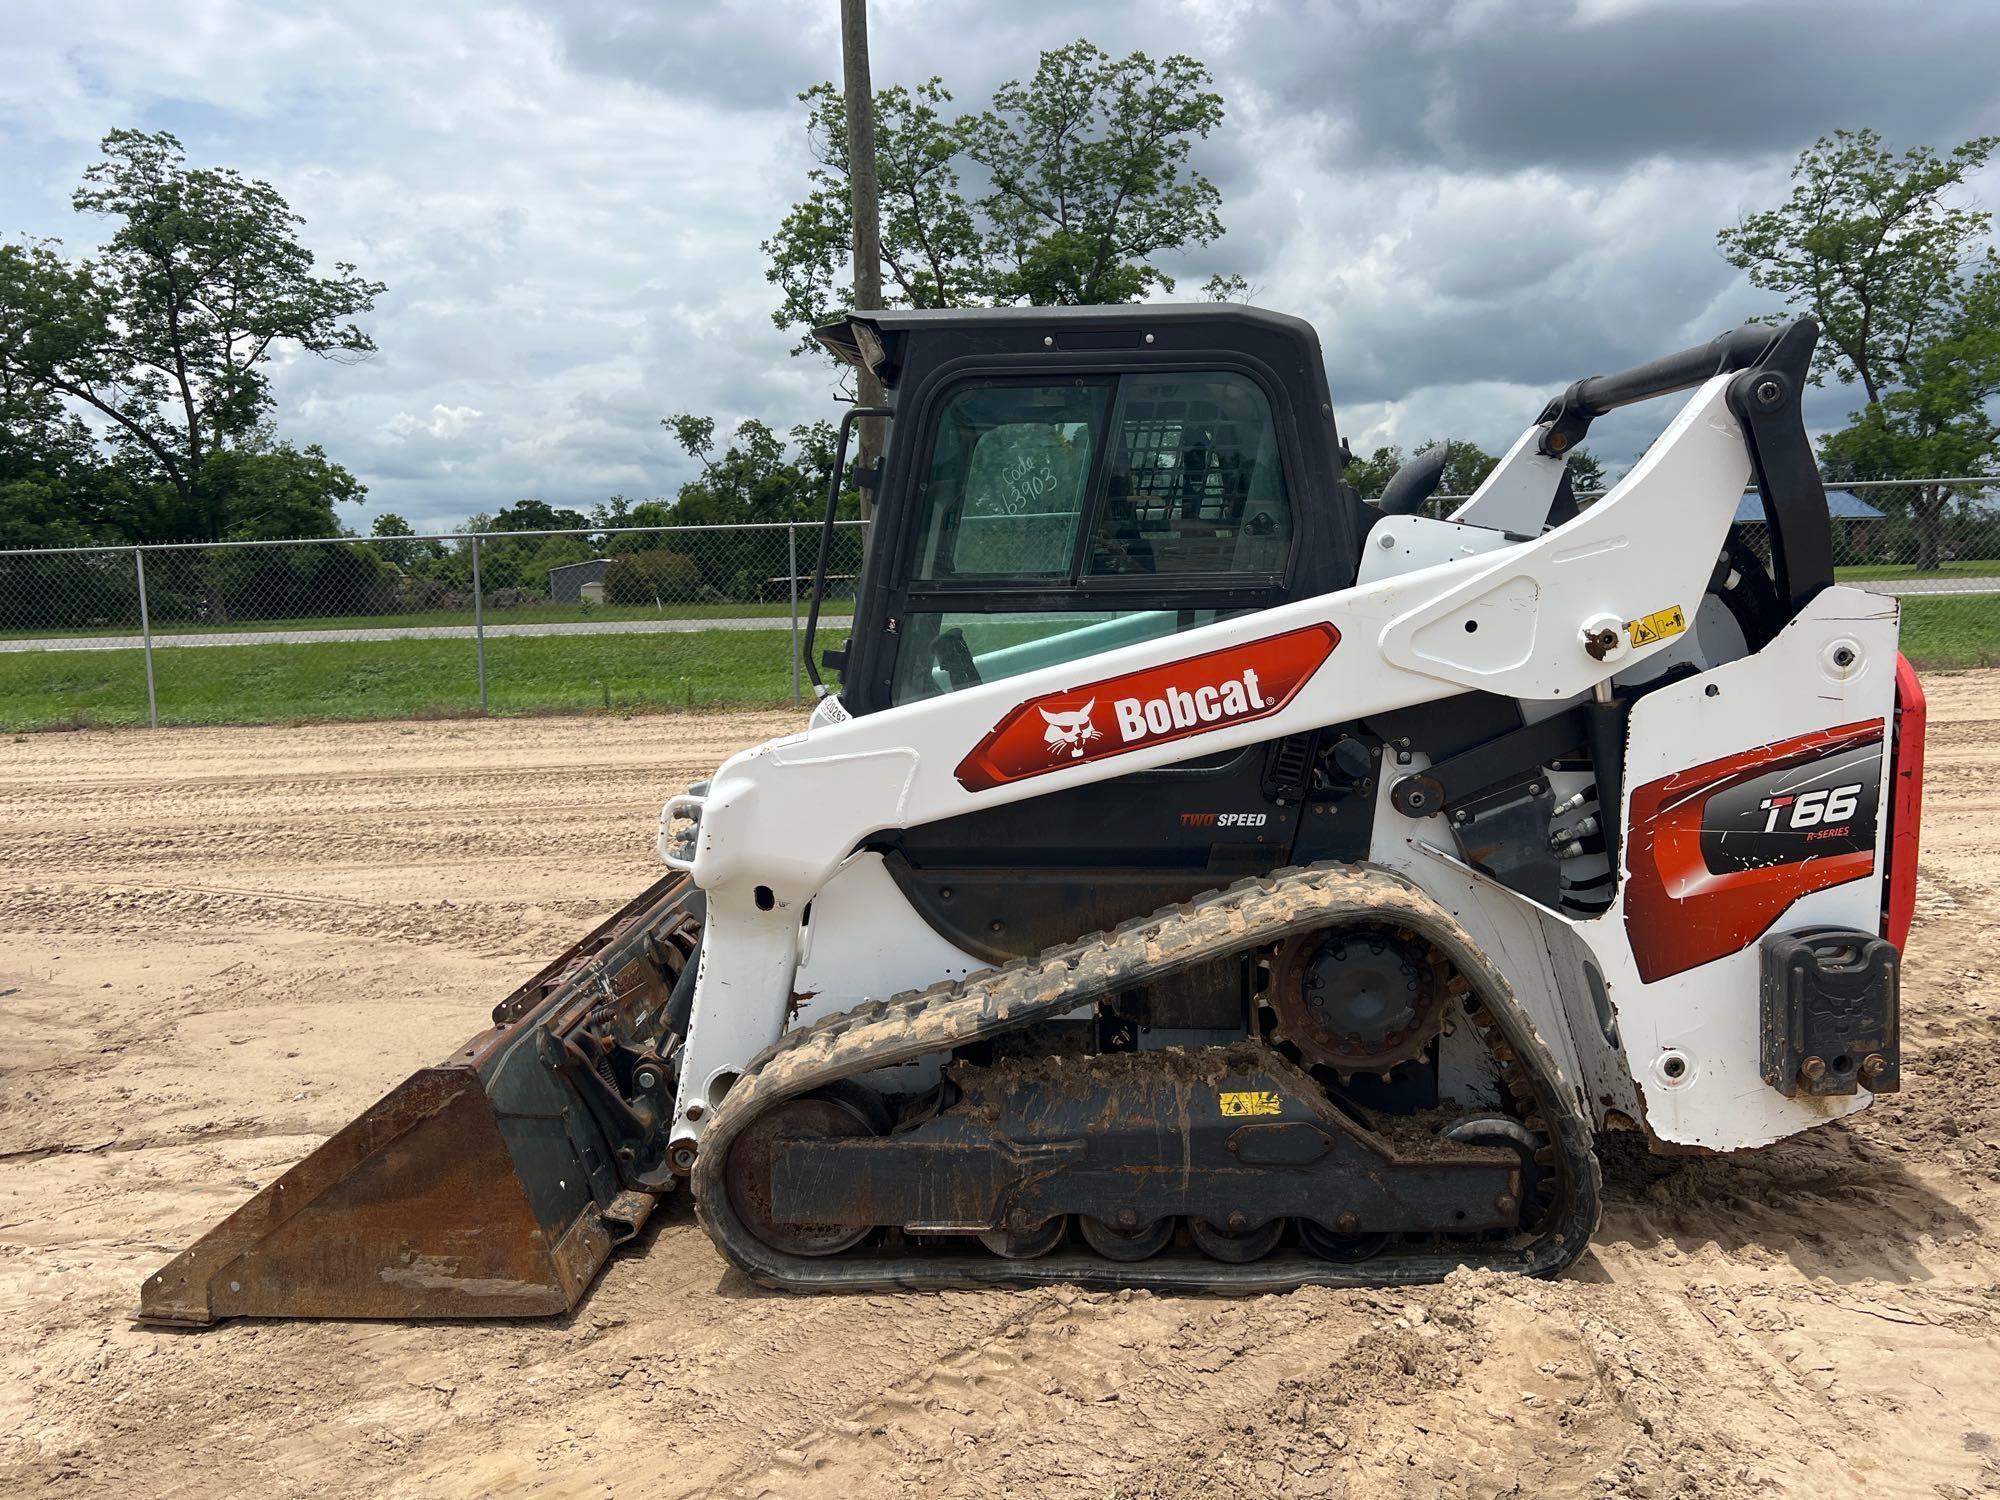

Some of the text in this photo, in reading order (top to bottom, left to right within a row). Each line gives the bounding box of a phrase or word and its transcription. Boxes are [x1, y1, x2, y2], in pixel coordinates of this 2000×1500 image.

[1114, 668, 1266, 742] Bobcat
[1181, 813, 1267, 827] TWO SPEED
[1759, 784, 1863, 833] T66
[1806, 826, 1851, 841] R-SERIES
